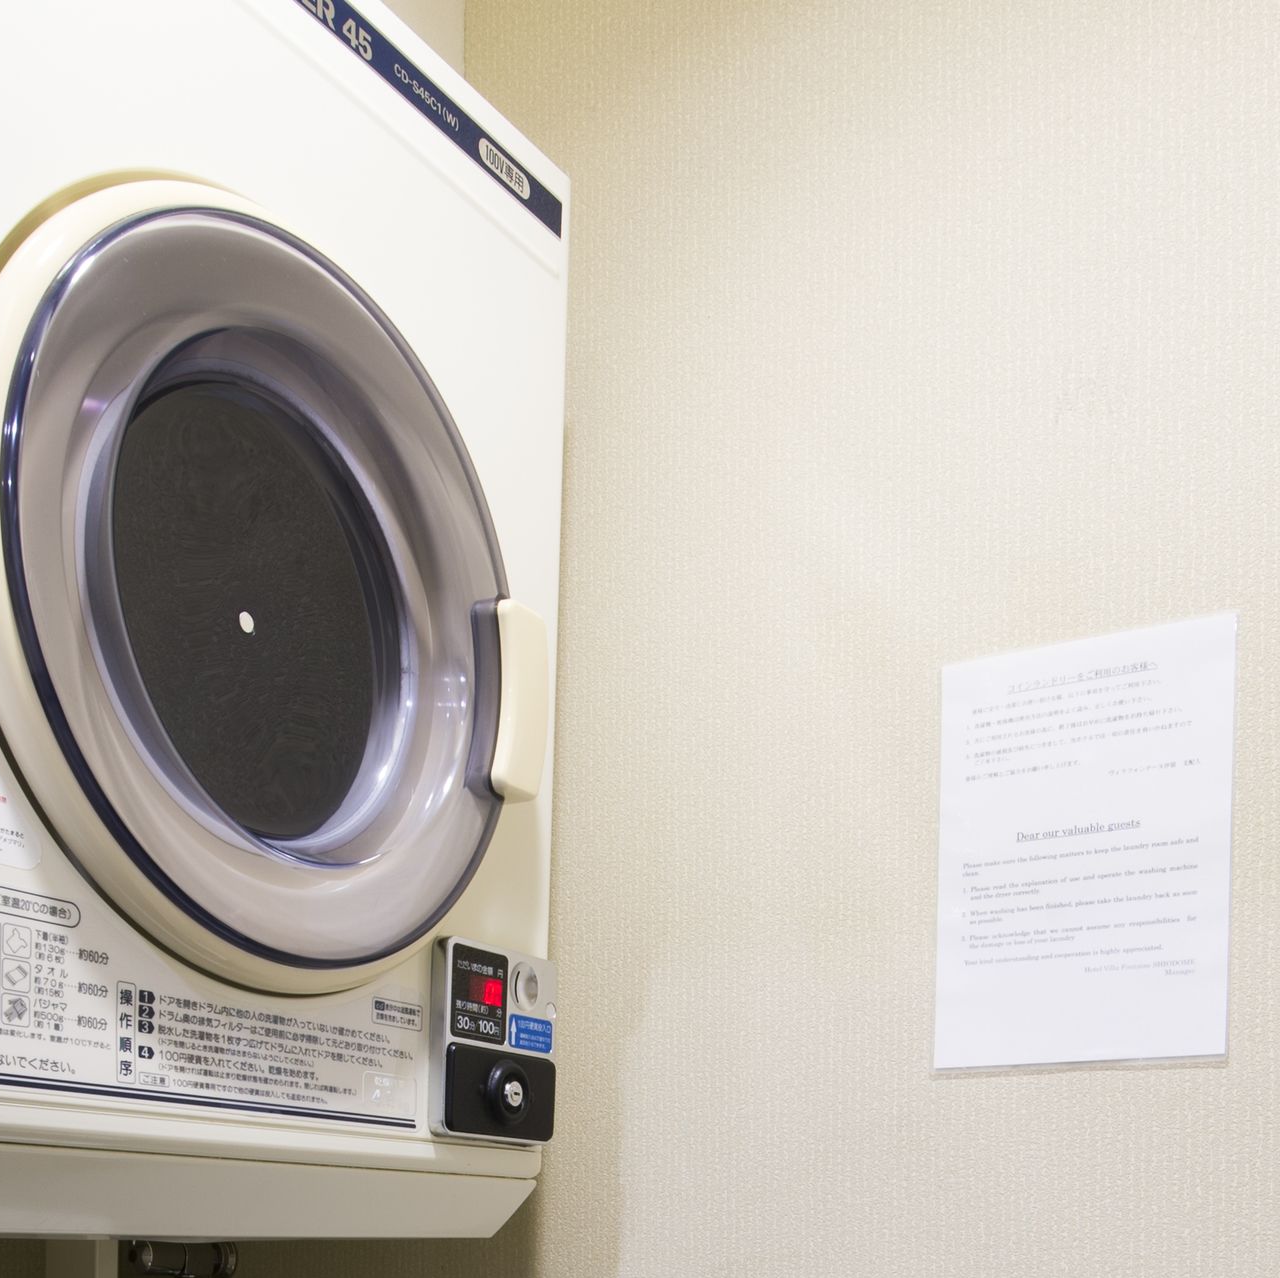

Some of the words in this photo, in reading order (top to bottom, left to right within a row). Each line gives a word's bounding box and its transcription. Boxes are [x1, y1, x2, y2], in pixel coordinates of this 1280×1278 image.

[342, 18, 373, 62] 45
[393, 63, 459, 131] CD-S45C1(W)
[484, 144, 524, 194] 100V専用
[1017, 831, 1040, 841] Dear
[1042, 830, 1060, 839] our
[1062, 822, 1105, 836] valuable
[1107, 819, 1141, 833] guests
[78, 948, 109, 965] 約60分
[77, 982, 109, 998] 約60分
[77, 1015, 108, 1031] 約60分
[119, 988, 133, 1076] 操作順序
[457, 1016, 475, 1031] 30分
[479, 1020, 500, 1036] 100円
